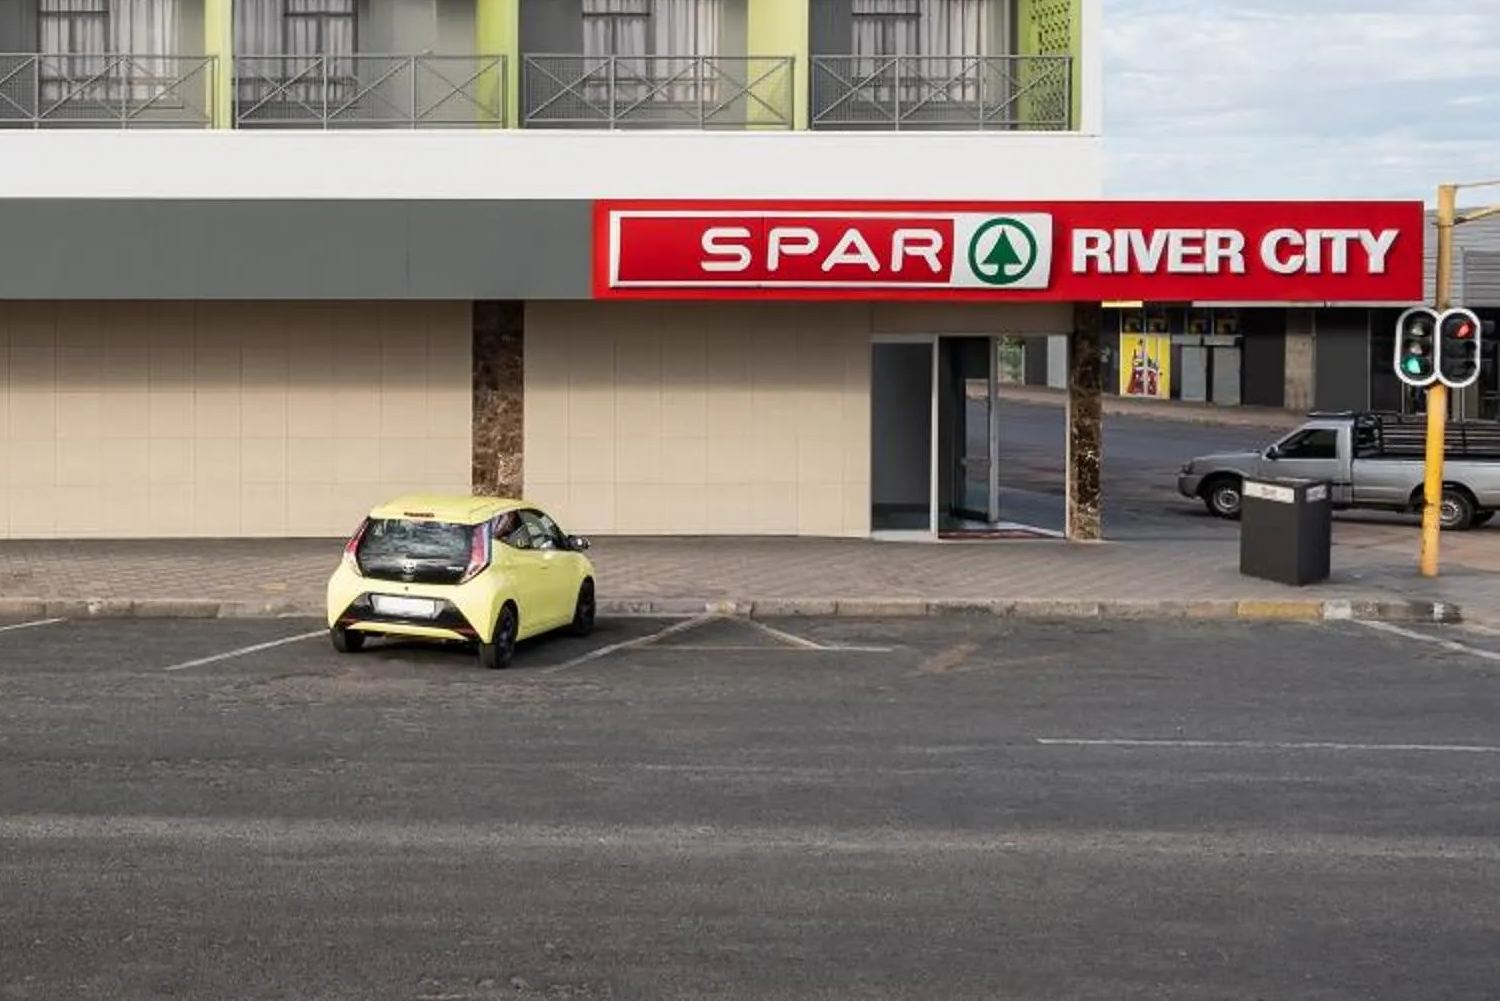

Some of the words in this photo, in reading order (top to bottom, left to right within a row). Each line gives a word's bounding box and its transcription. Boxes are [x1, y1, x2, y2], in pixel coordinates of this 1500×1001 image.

[700, 227, 943, 274] SPAR
[1071, 228, 1245, 274] RIVER
[1260, 228, 1400, 274] CITY
